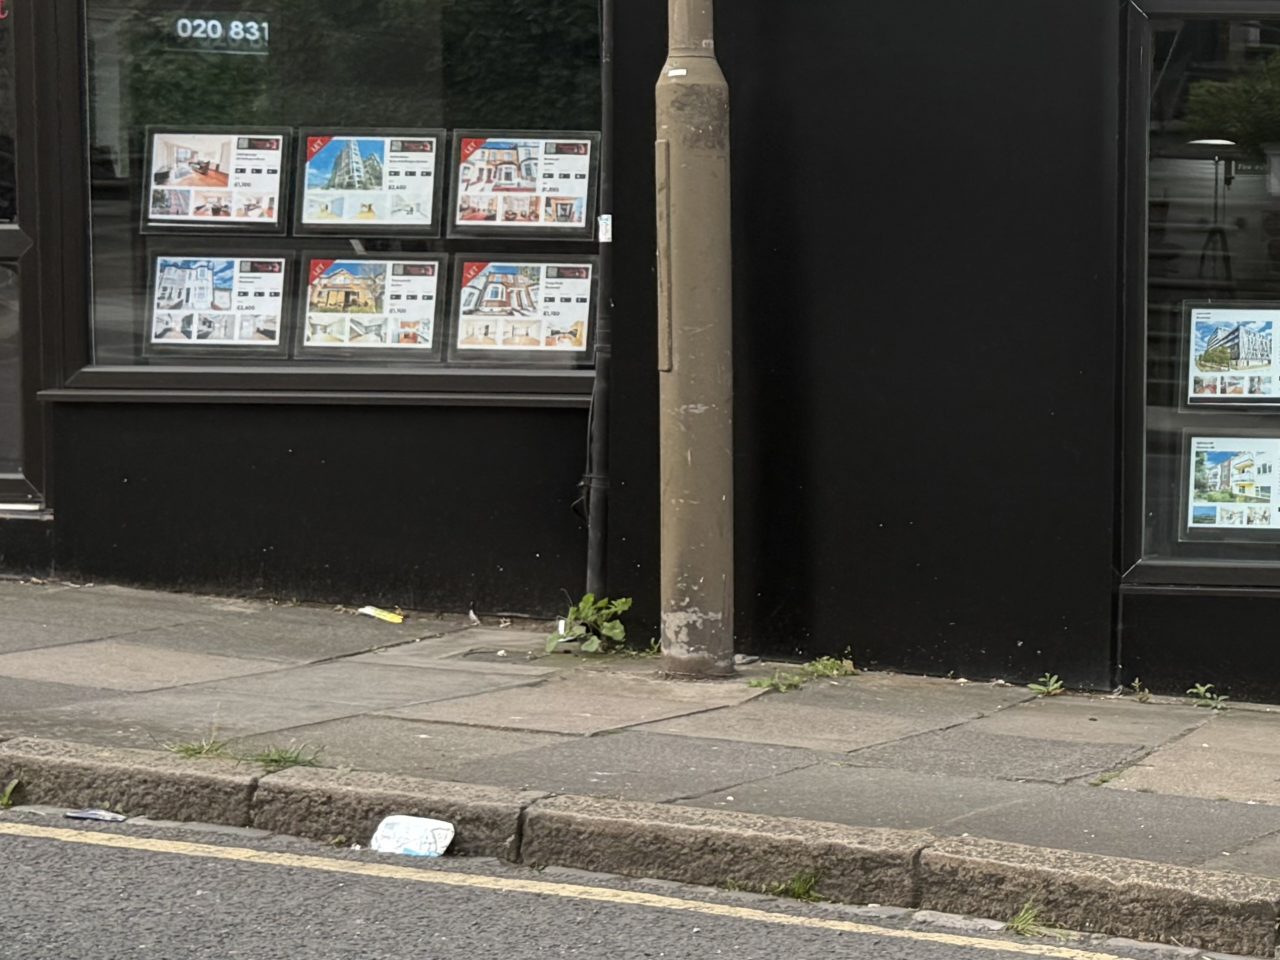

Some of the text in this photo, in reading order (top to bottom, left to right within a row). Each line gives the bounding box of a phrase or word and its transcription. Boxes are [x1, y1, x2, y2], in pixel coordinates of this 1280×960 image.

[177, 18, 269, 41] 020 831
[311, 139, 324, 152] LET
[464, 141, 477, 154] LET
[313, 263, 326, 276] LET
[466, 266, 479, 278] LET
